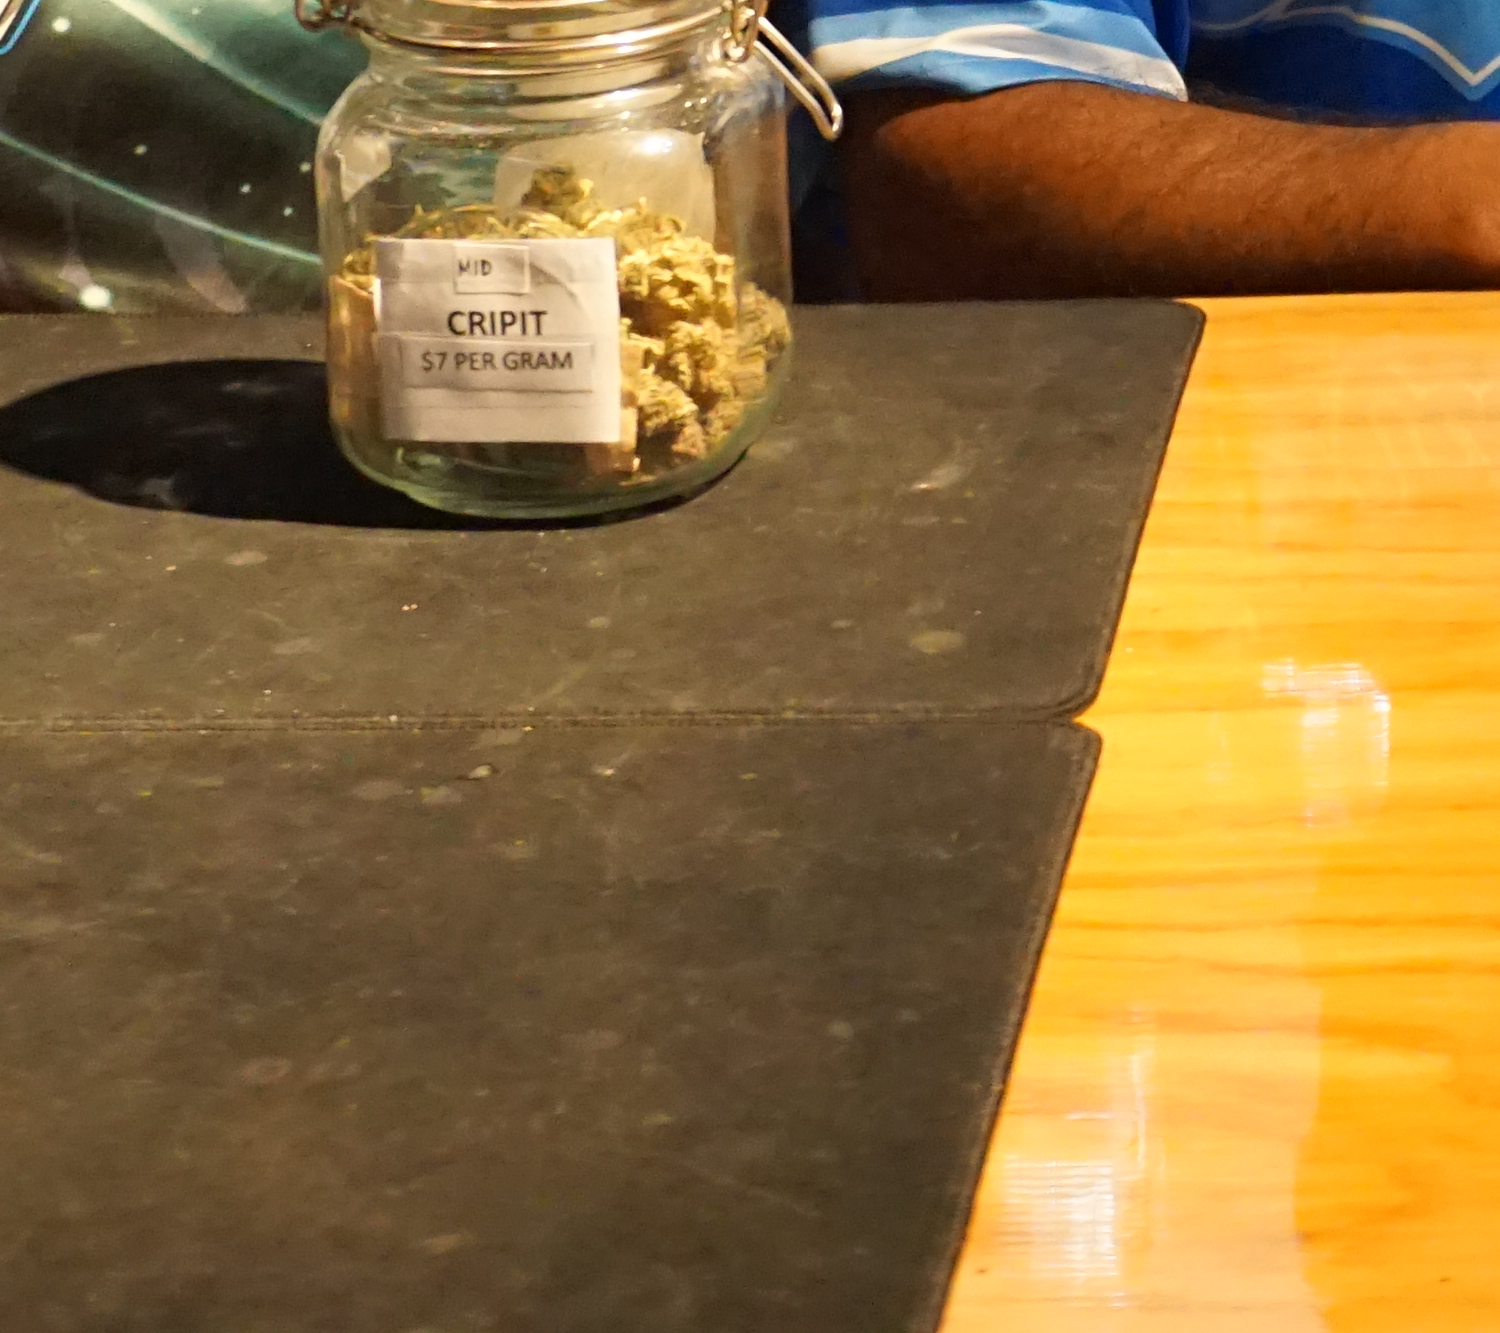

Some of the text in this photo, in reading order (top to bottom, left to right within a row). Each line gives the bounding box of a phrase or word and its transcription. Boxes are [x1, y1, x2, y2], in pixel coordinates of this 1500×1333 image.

[457, 258, 493, 277] MID
[446, 309, 549, 337] CRIPIT
[420, 350, 574, 374] $7 PER GRAM
